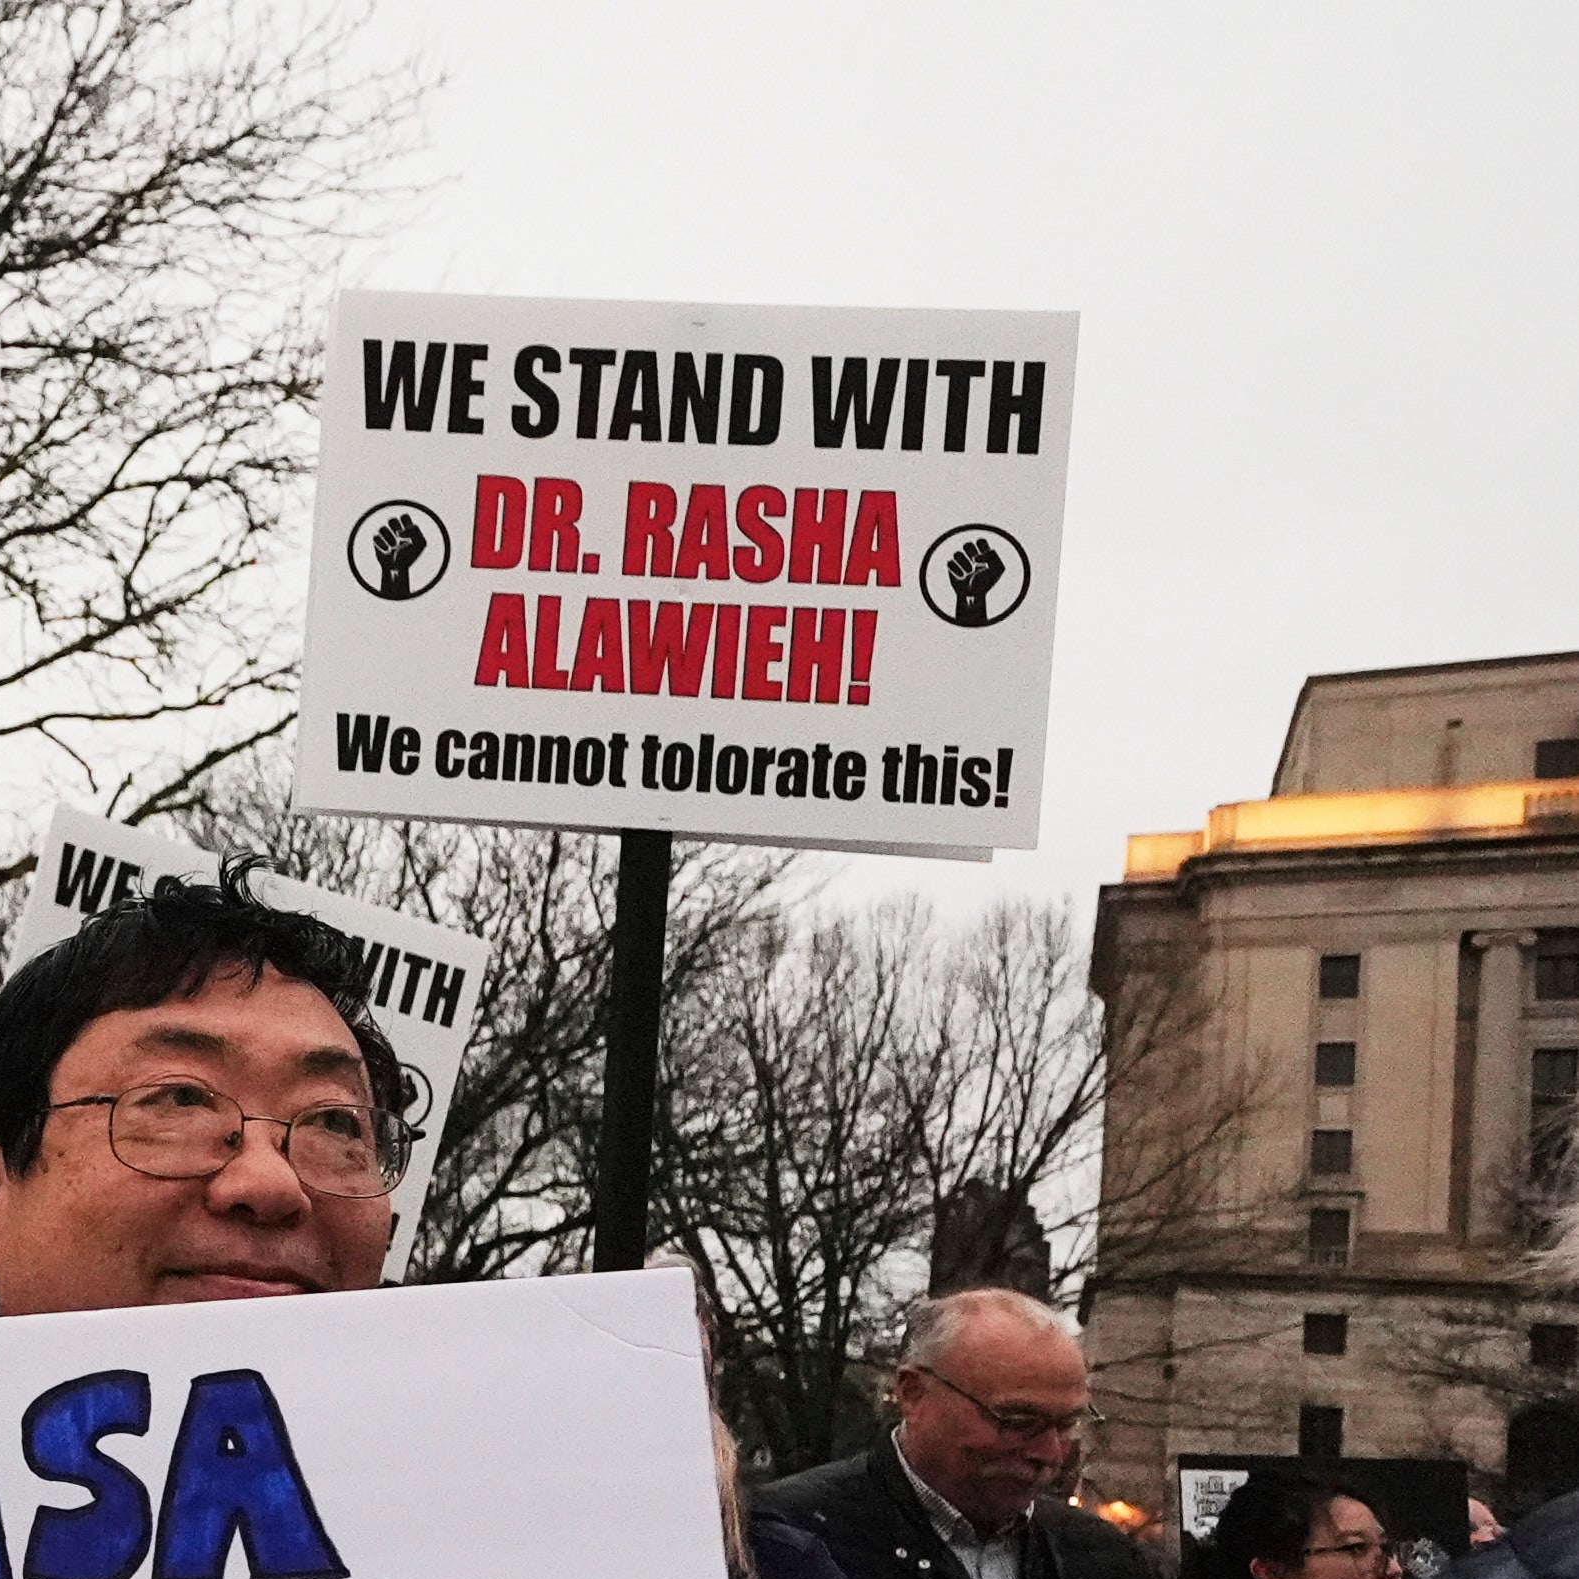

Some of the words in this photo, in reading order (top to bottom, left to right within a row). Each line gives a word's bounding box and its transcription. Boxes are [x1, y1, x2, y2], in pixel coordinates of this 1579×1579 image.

[363, 338, 487, 436] WE
[511, 344, 784, 447] STAND
[810, 355, 1046, 455] WITH
[470, 474, 600, 574] DR.
[621, 480, 902, 588] RASHA
[474, 592, 879, 706] ALAWIEH!
[335, 712, 420, 776] We
[435, 727, 629, 788] cannot
[642, 733, 865, 801] tolorate
[882, 743, 1014, 809] this!
